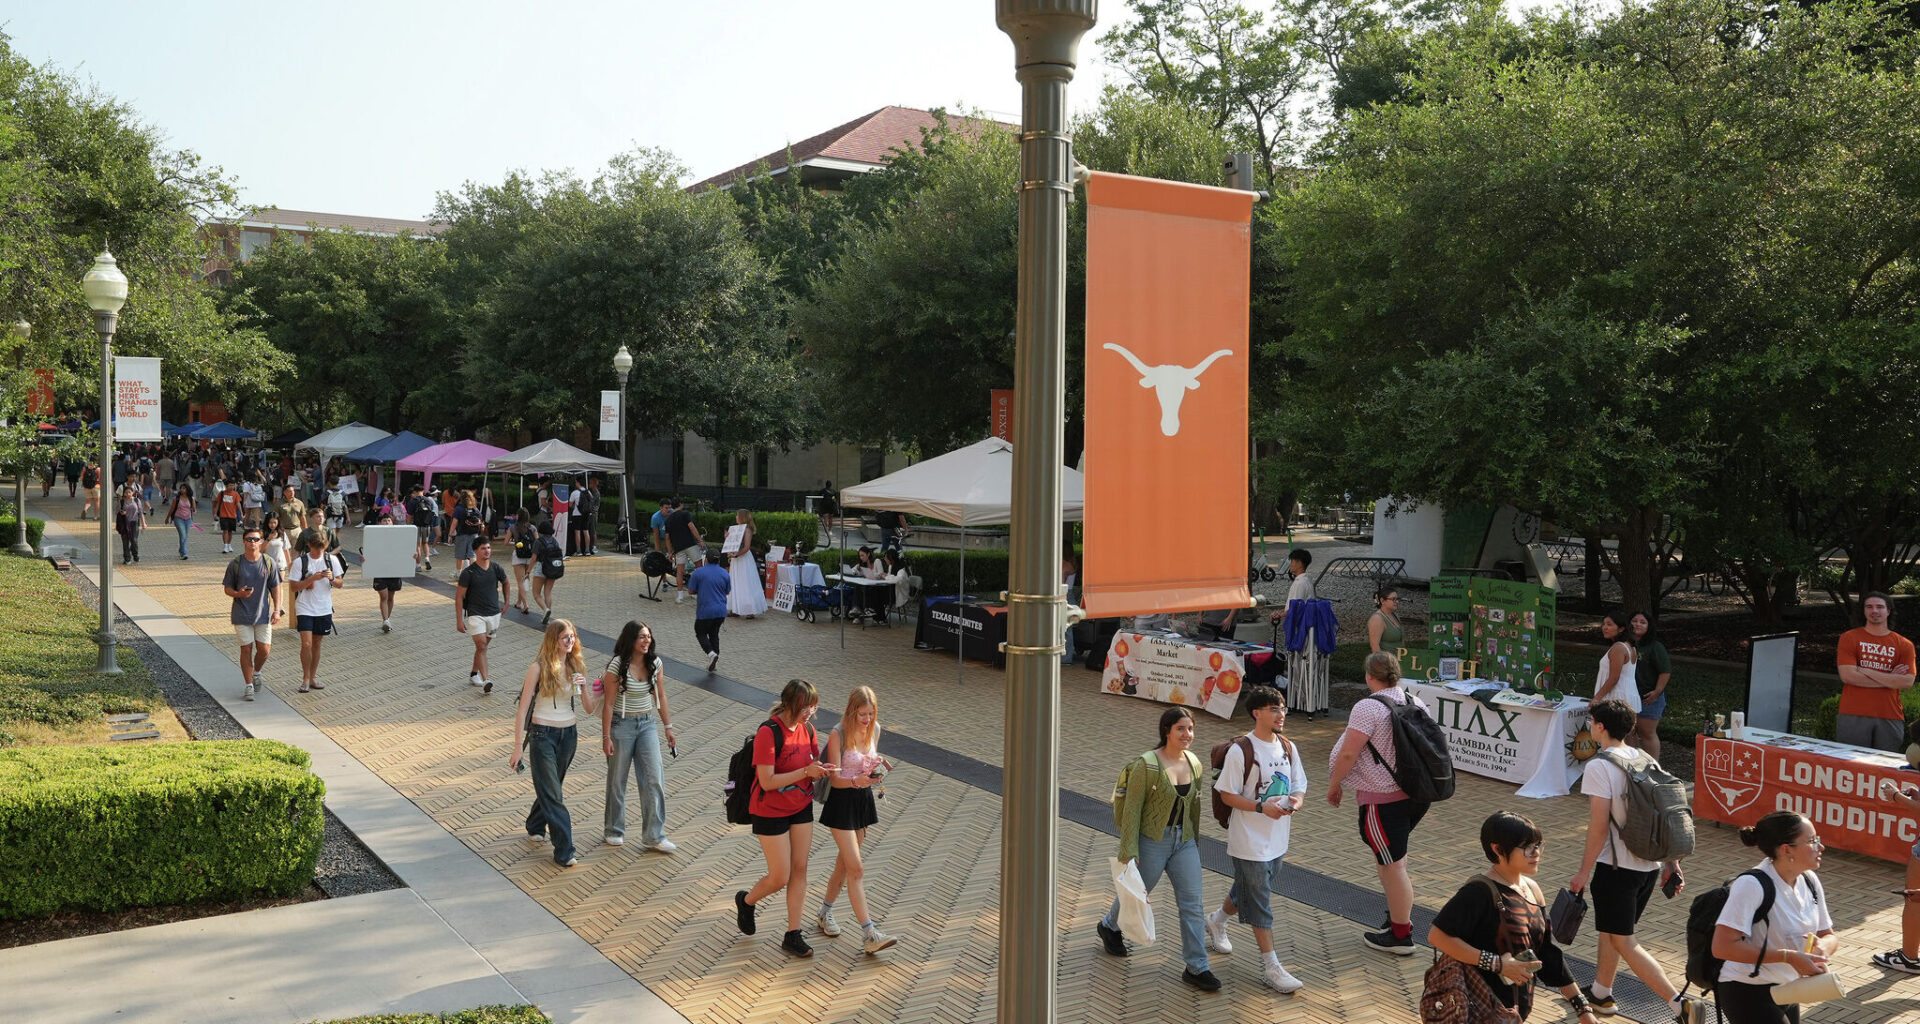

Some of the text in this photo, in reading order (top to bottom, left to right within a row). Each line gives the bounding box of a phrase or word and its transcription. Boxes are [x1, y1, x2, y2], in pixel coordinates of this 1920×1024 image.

[999, 407, 1007, 441] TEXAS
[778, 583, 793, 593] JOIN
[775, 601, 789, 609] CREW
[932, 610, 983, 630] TEXAS ININITES
[1156, 648, 1178, 658] Market
[1860, 641, 1896, 657] TEXAS
[1449, 733, 1492, 752] LAMBDA
[1491, 763, 1507, 773] 1994
